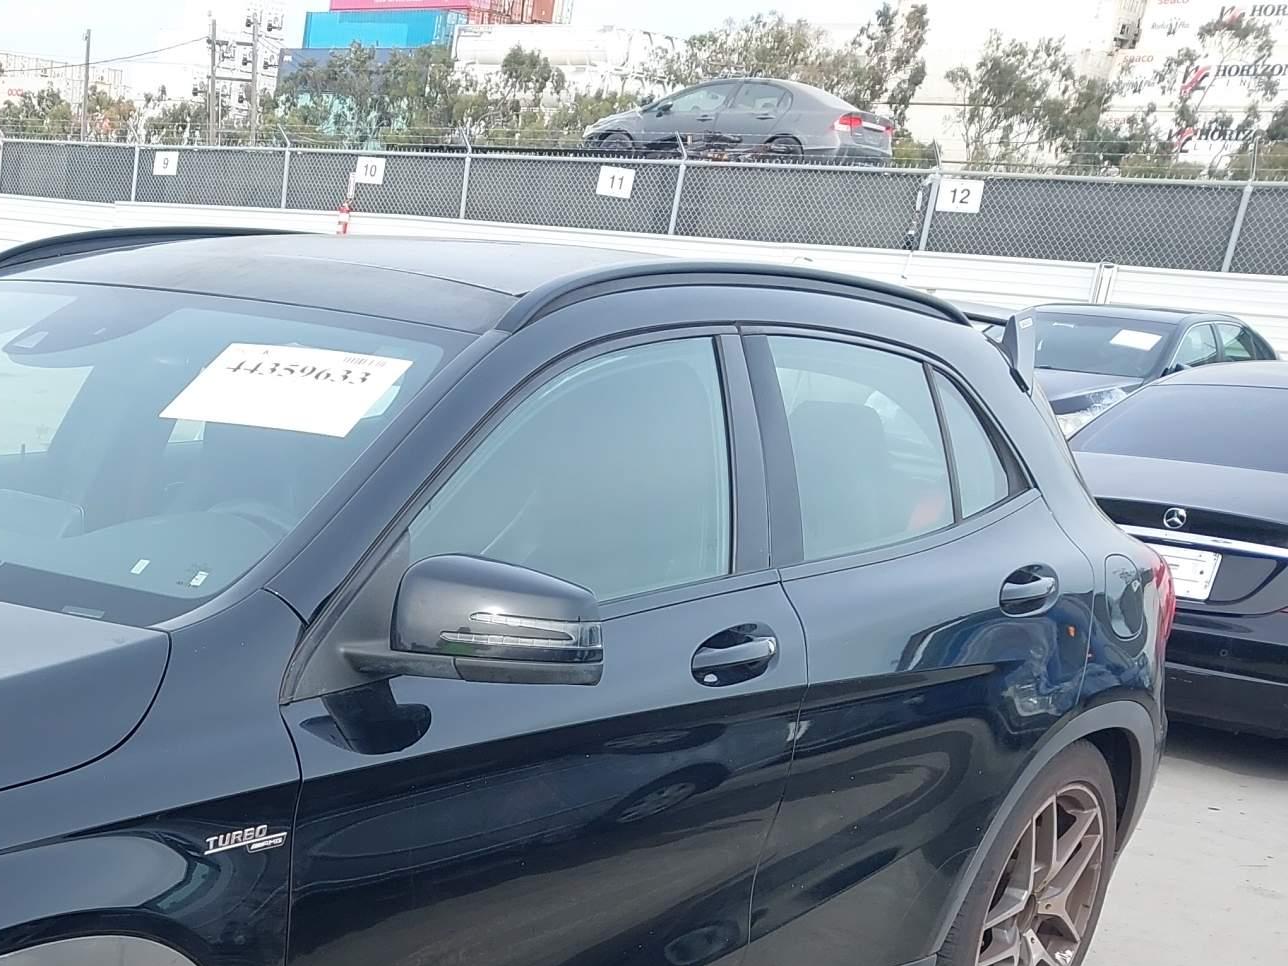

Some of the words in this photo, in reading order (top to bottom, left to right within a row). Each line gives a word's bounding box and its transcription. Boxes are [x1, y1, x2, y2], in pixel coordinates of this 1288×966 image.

[1198, 128, 1255, 141] HORIZ
[162, 157, 169, 169] 9
[364, 163, 377, 177] 10
[610, 175, 624, 190] 11
[950, 188, 971, 204] 12
[226, 360, 372, 385] 44359633
[205, 825, 268, 850] TURBO
